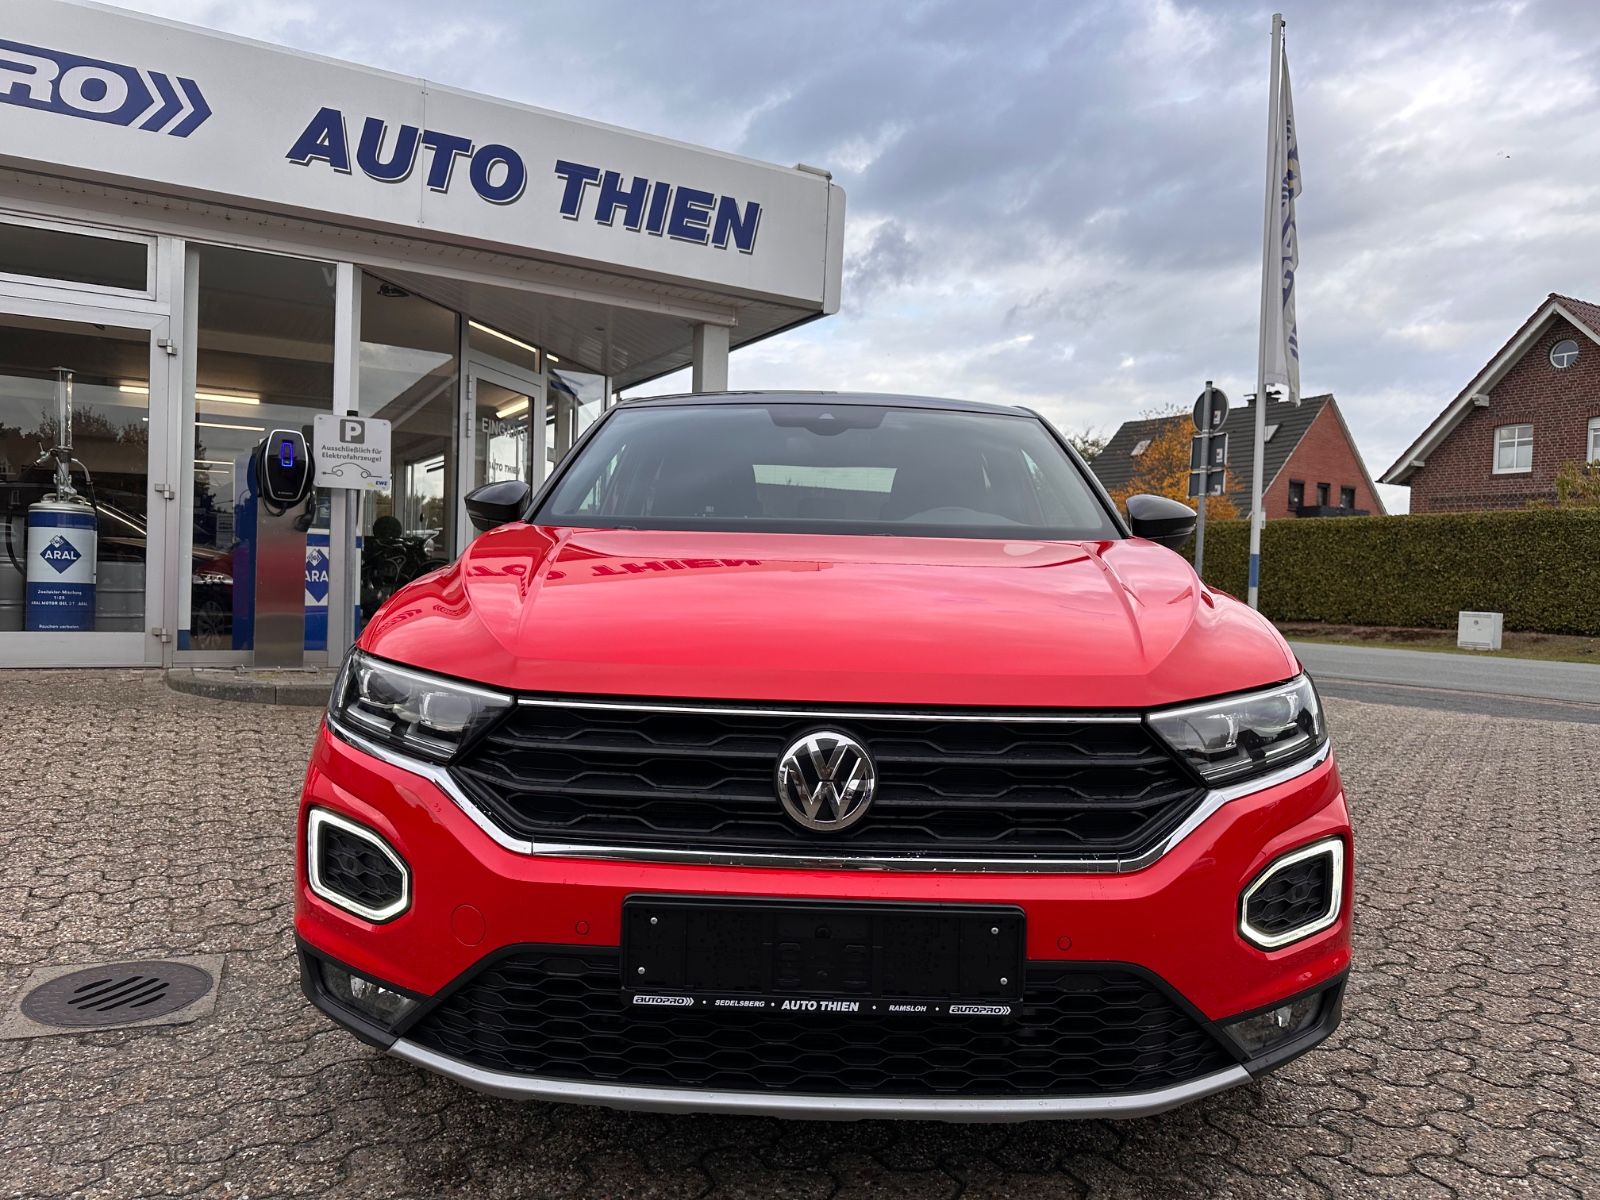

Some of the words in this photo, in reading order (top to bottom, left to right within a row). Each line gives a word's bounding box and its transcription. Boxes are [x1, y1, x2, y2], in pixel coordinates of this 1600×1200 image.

[285, 106, 528, 206] AUTO
[554, 159, 762, 255] THIEN
[344, 421, 362, 442] P
[321, 445, 371, 454] Ausschließlich
[44, 550, 78, 560] ARAL
[776, 731, 875, 831] VW
[714, 999, 765, 1008] SEDELSBERG
[781, 1000, 817, 1011] AUTO
[819, 1001, 860, 1012] THIEN
[888, 1004, 927, 1013] RAMSLOH
